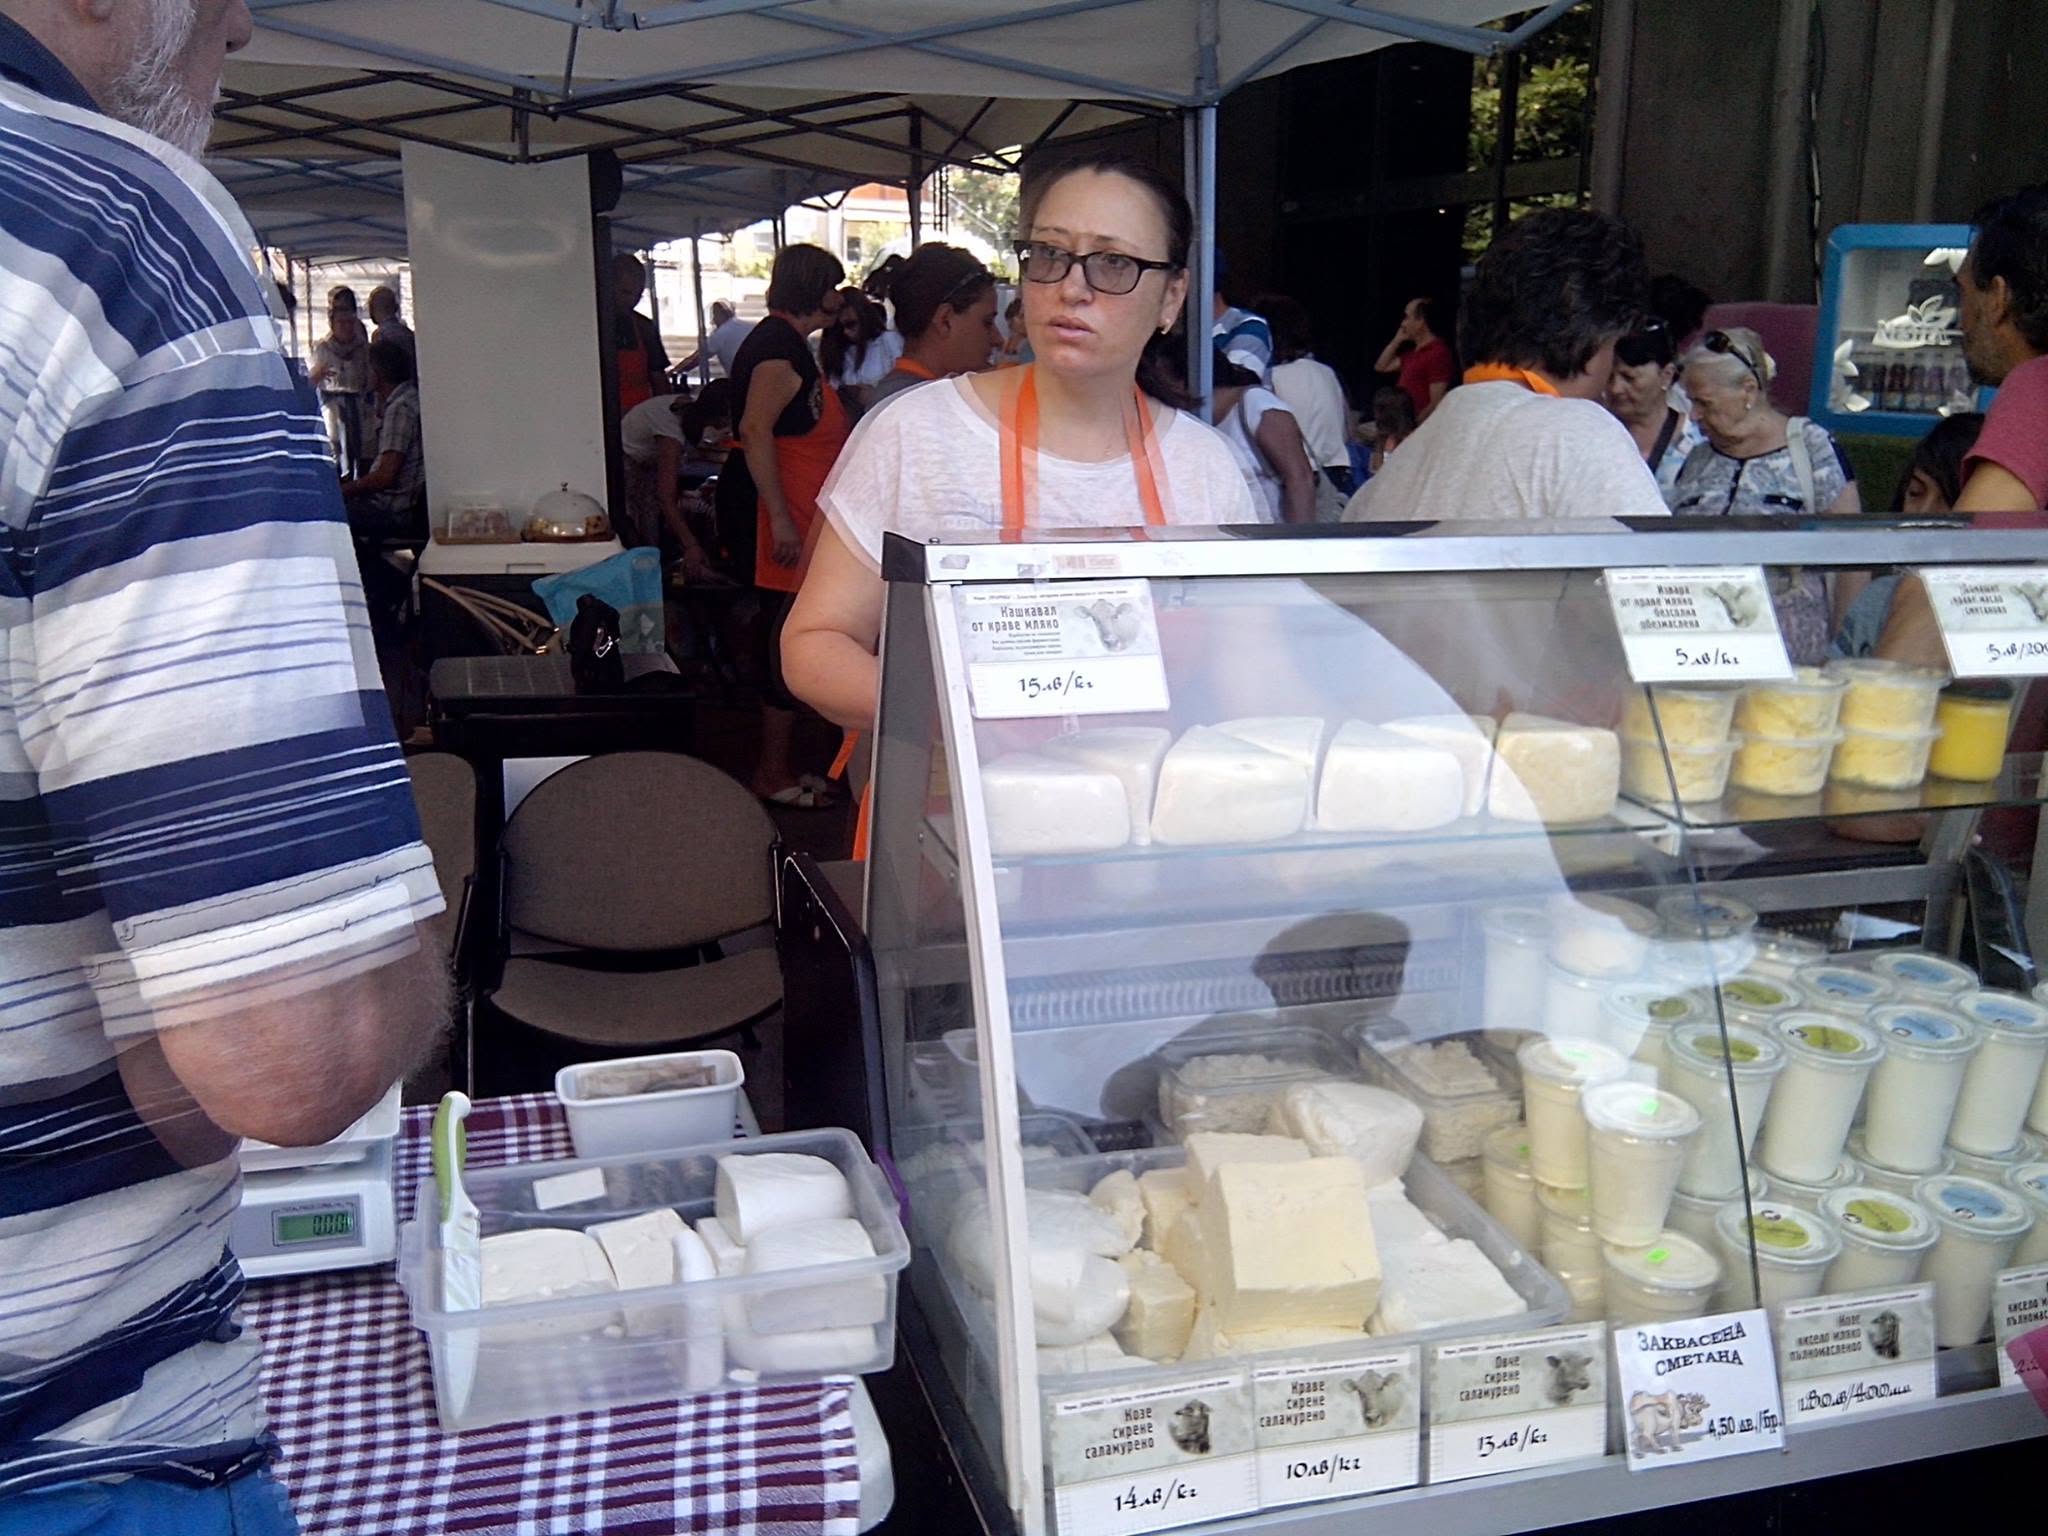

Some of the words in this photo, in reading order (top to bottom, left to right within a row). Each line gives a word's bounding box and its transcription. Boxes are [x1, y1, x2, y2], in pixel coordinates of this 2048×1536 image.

[1000, 605, 1057, 619] Кашкавал
[971, 619, 984, 632] от
[987, 620, 1021, 633] краве
[1024, 618, 1060, 631] мляко
[1637, 1321, 1747, 1351] ЗАКВАСЕНА
[1495, 1356, 1520, 1369] Овче
[1655, 1350, 1744, 1377] СМЕТАНА
[1484, 1370, 1520, 1385] сирене
[1291, 1380, 1325, 1395] Краве
[1459, 1384, 1521, 1402] саламурено
[1286, 1395, 1326, 1411] сирене
[1125, 1407, 1153, 1422] Козе
[1259, 1410, 1326, 1428] саламурено
[1112, 1422, 1154, 1439] сирене
[1085, 1437, 1155, 1459] саламурено
